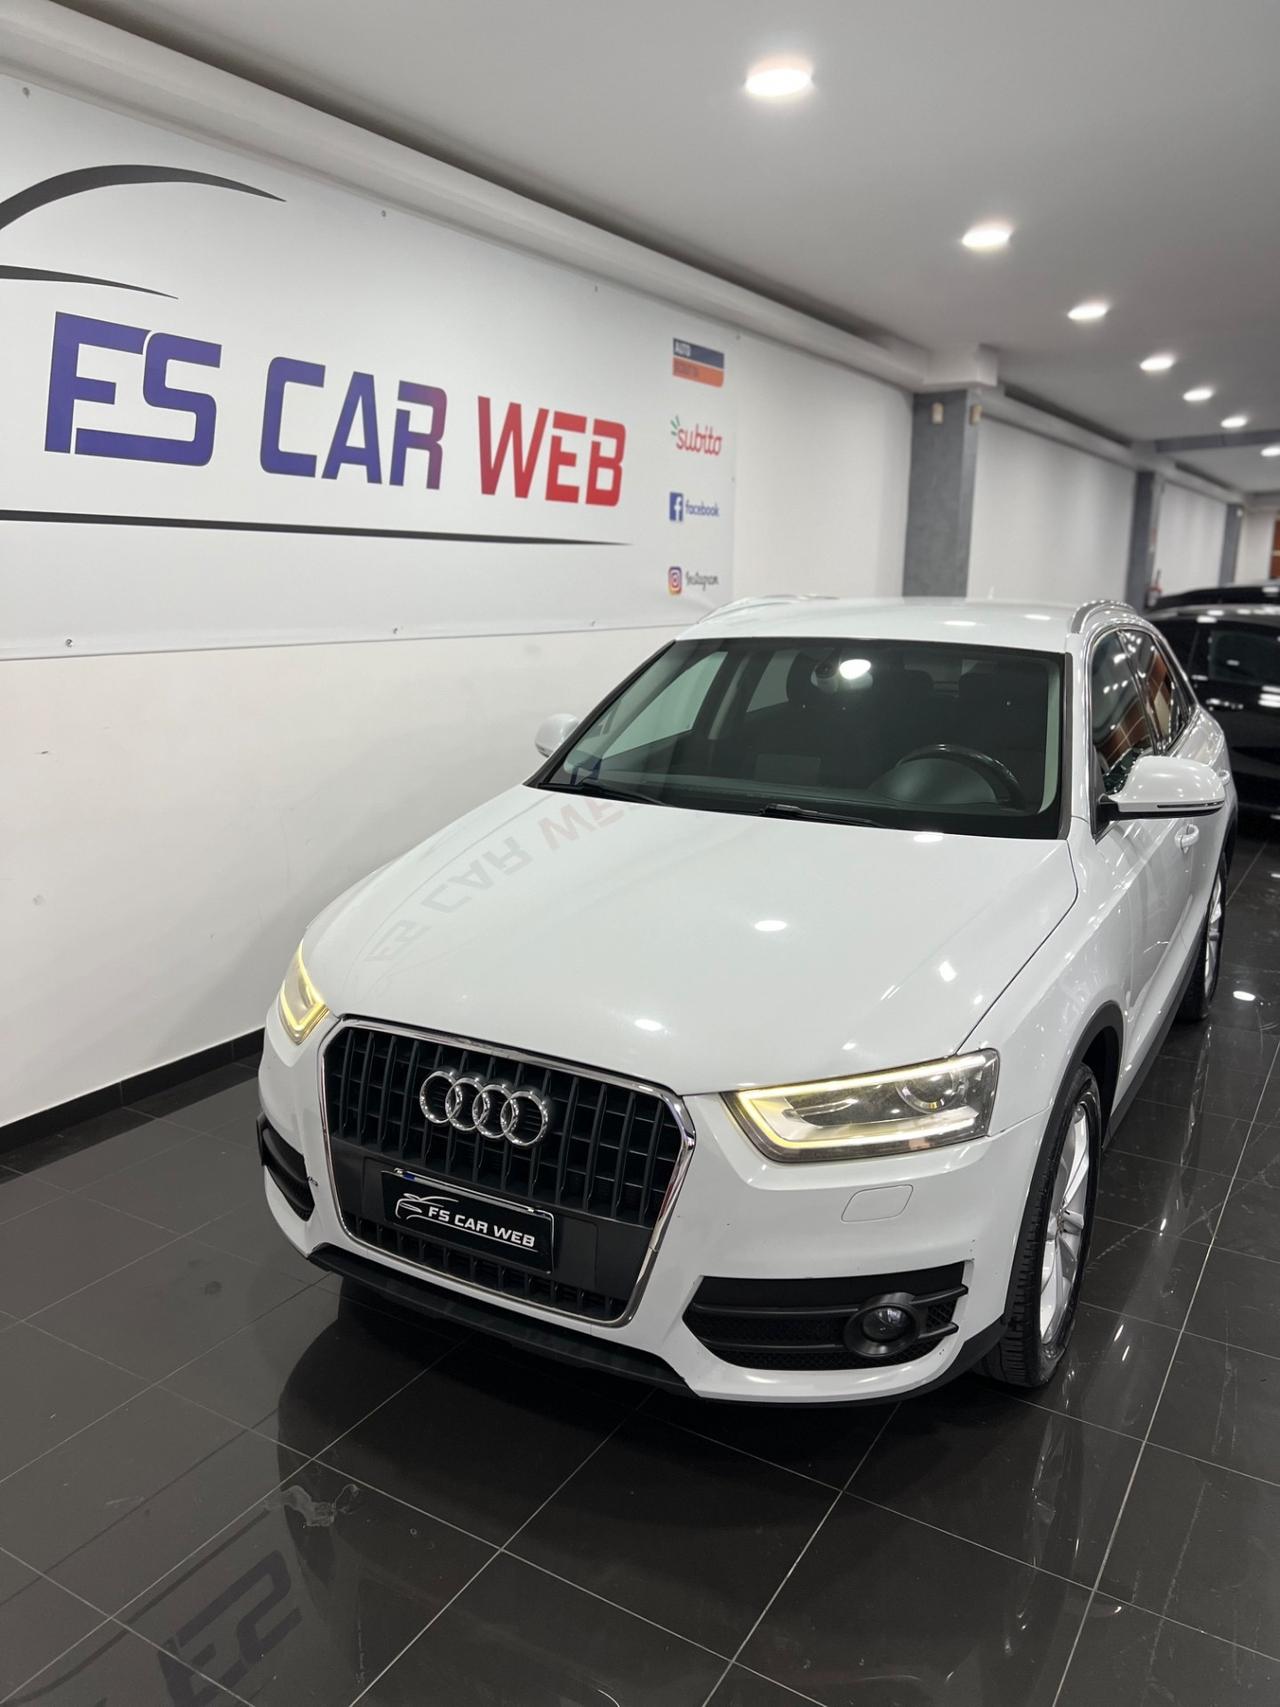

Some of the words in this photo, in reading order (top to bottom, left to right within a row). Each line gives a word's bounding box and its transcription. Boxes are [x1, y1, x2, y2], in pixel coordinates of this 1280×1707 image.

[44, 311, 222, 467] FS
[259, 356, 447, 490] CAR
[476, 395, 627, 507] WEB
[676, 422, 723, 456] subito
[685, 499, 720, 517] facebook
[428, 1206, 450, 1222] FS
[454, 1214, 488, 1234] CAR
[493, 1225, 535, 1248] WEB
